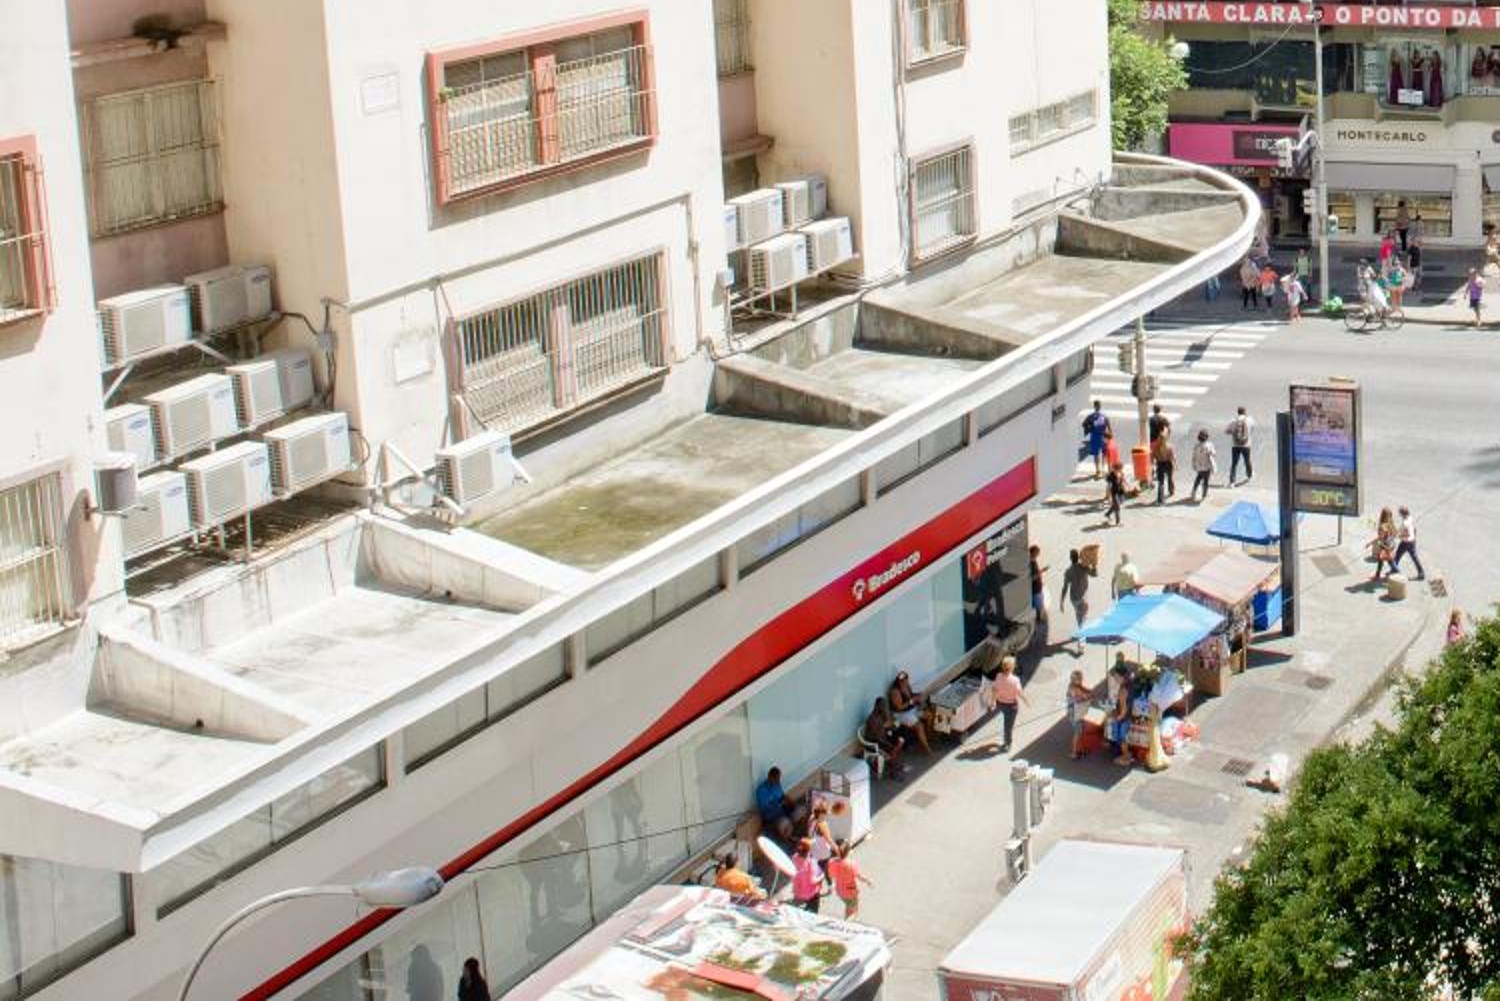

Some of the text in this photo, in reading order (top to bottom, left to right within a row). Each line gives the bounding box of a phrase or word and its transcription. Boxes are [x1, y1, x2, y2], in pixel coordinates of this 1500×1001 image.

[1140, 2, 1210, 21] SANTA
[1224, 4, 1302, 23] CLARA
[1336, 7, 1350, 23] O
[1361, 7, 1441, 25] PONTO
[1452, 8, 1482, 26] DA
[1337, 130, 1427, 143] MONTECARLO
